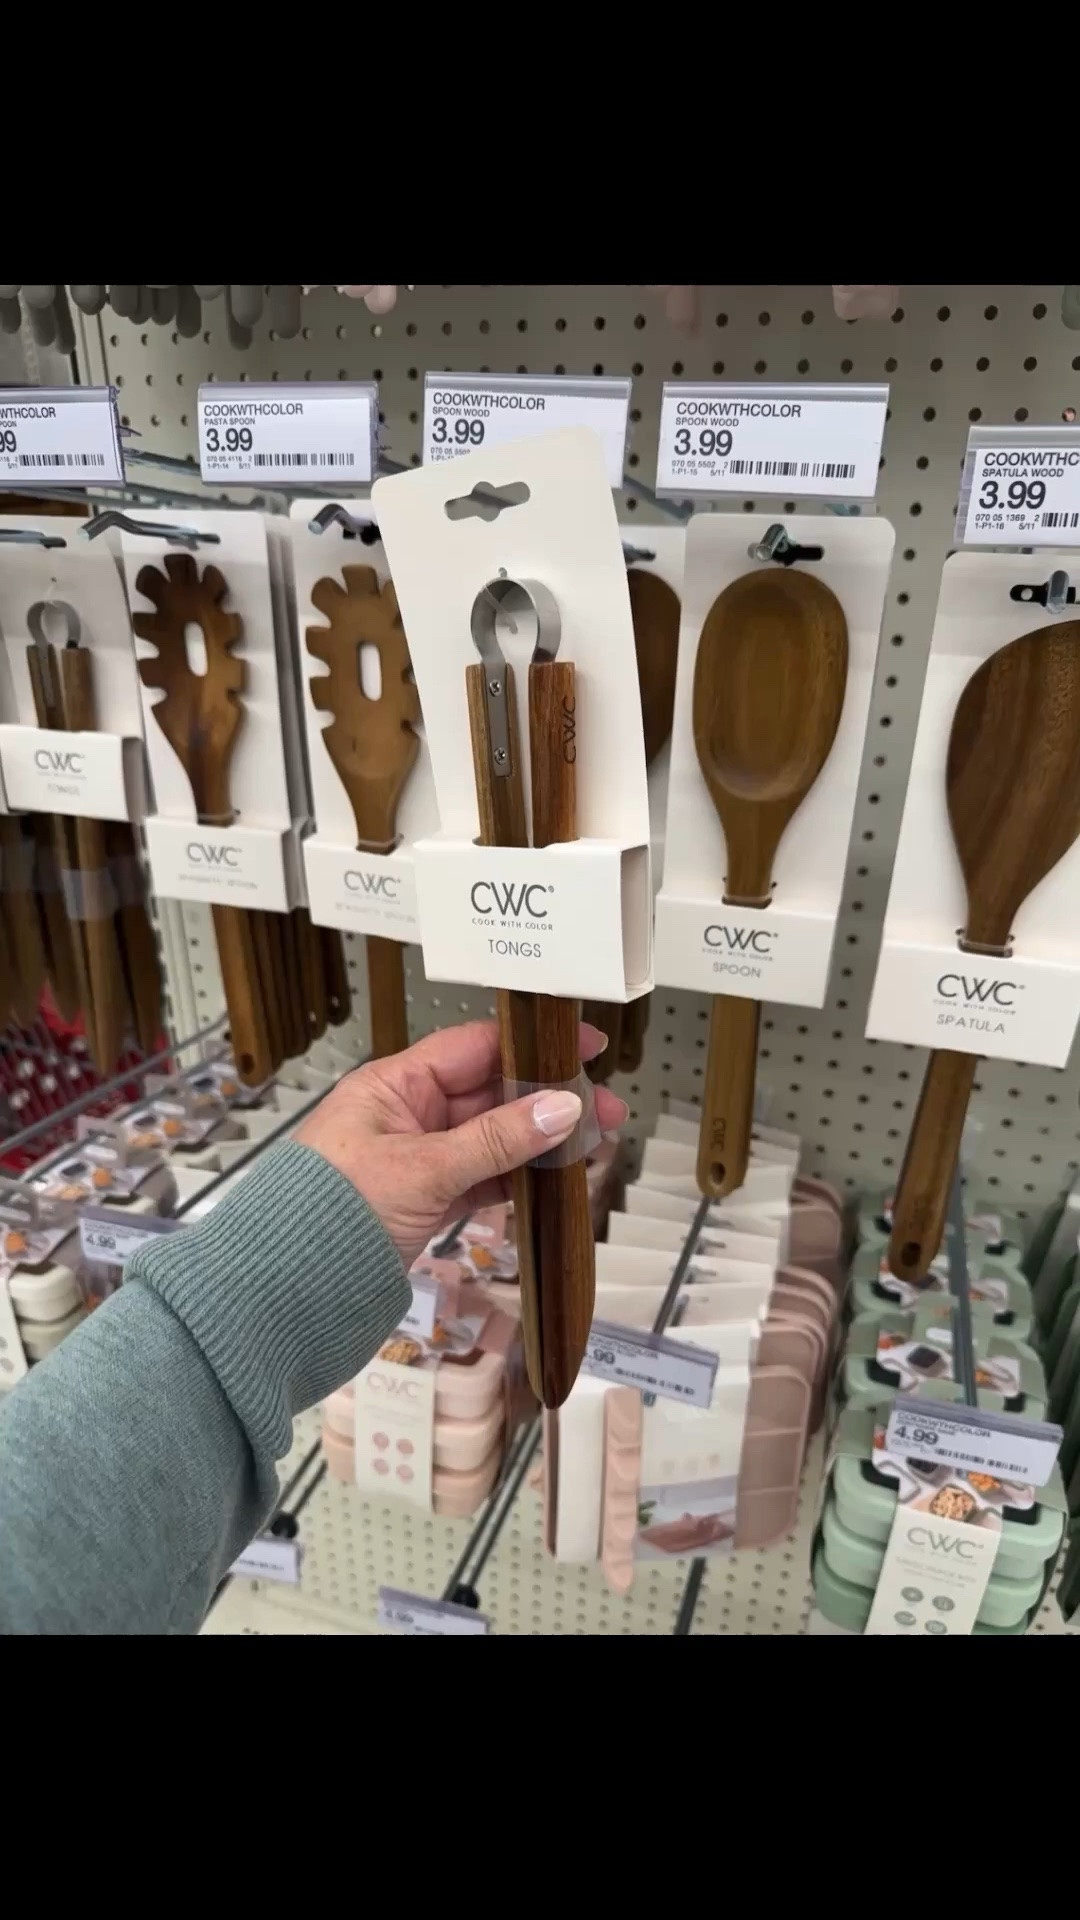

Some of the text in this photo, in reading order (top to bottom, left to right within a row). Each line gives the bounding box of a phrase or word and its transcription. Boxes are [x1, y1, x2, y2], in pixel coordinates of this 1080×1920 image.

[203, 403, 304, 416] COOKWTHCOLOR
[432, 406, 490, 417] SPOON WOOD
[433, 392, 546, 411] COOKWTHCOLOR
[676, 402, 802, 418] COOKWTHCOLOR
[204, 417, 255, 426] PASTA SPOON
[432, 417, 485, 446] 3.99
[675, 417, 740, 427] SPOON WOOD
[206, 427, 253, 452] 3.99
[673, 428, 733, 457] 3.99
[984, 452, 1080, 466] COOKWTHC
[982, 468, 1065, 477] SPATULA WOOD
[978, 480, 1046, 510] 3.99
[975, 513, 991, 522] 070
[992, 513, 1003, 522] 05
[1006, 513, 1026, 522] 1369
[1018, 522, 1035, 531] 5/11
[562, 695, 577, 764] CWC
[34, 749, 83, 774] CWC
[187, 842, 239, 867] CWC
[343, 870, 397, 898] CWC
[470, 881, 548, 918] CWC
[472, 917, 553, 931] COOK WITH COLOR
[488, 938, 542, 958] TONGS
[703, 925, 772, 953] CWC
[712, 961, 762, 978] SPOON
[937, 974, 1017, 1006] CWC
[936, 1013, 1005, 1034] SPATULA
[894, 1425, 940, 1446] 4.99
[907, 1527, 977, 1559] CWC
